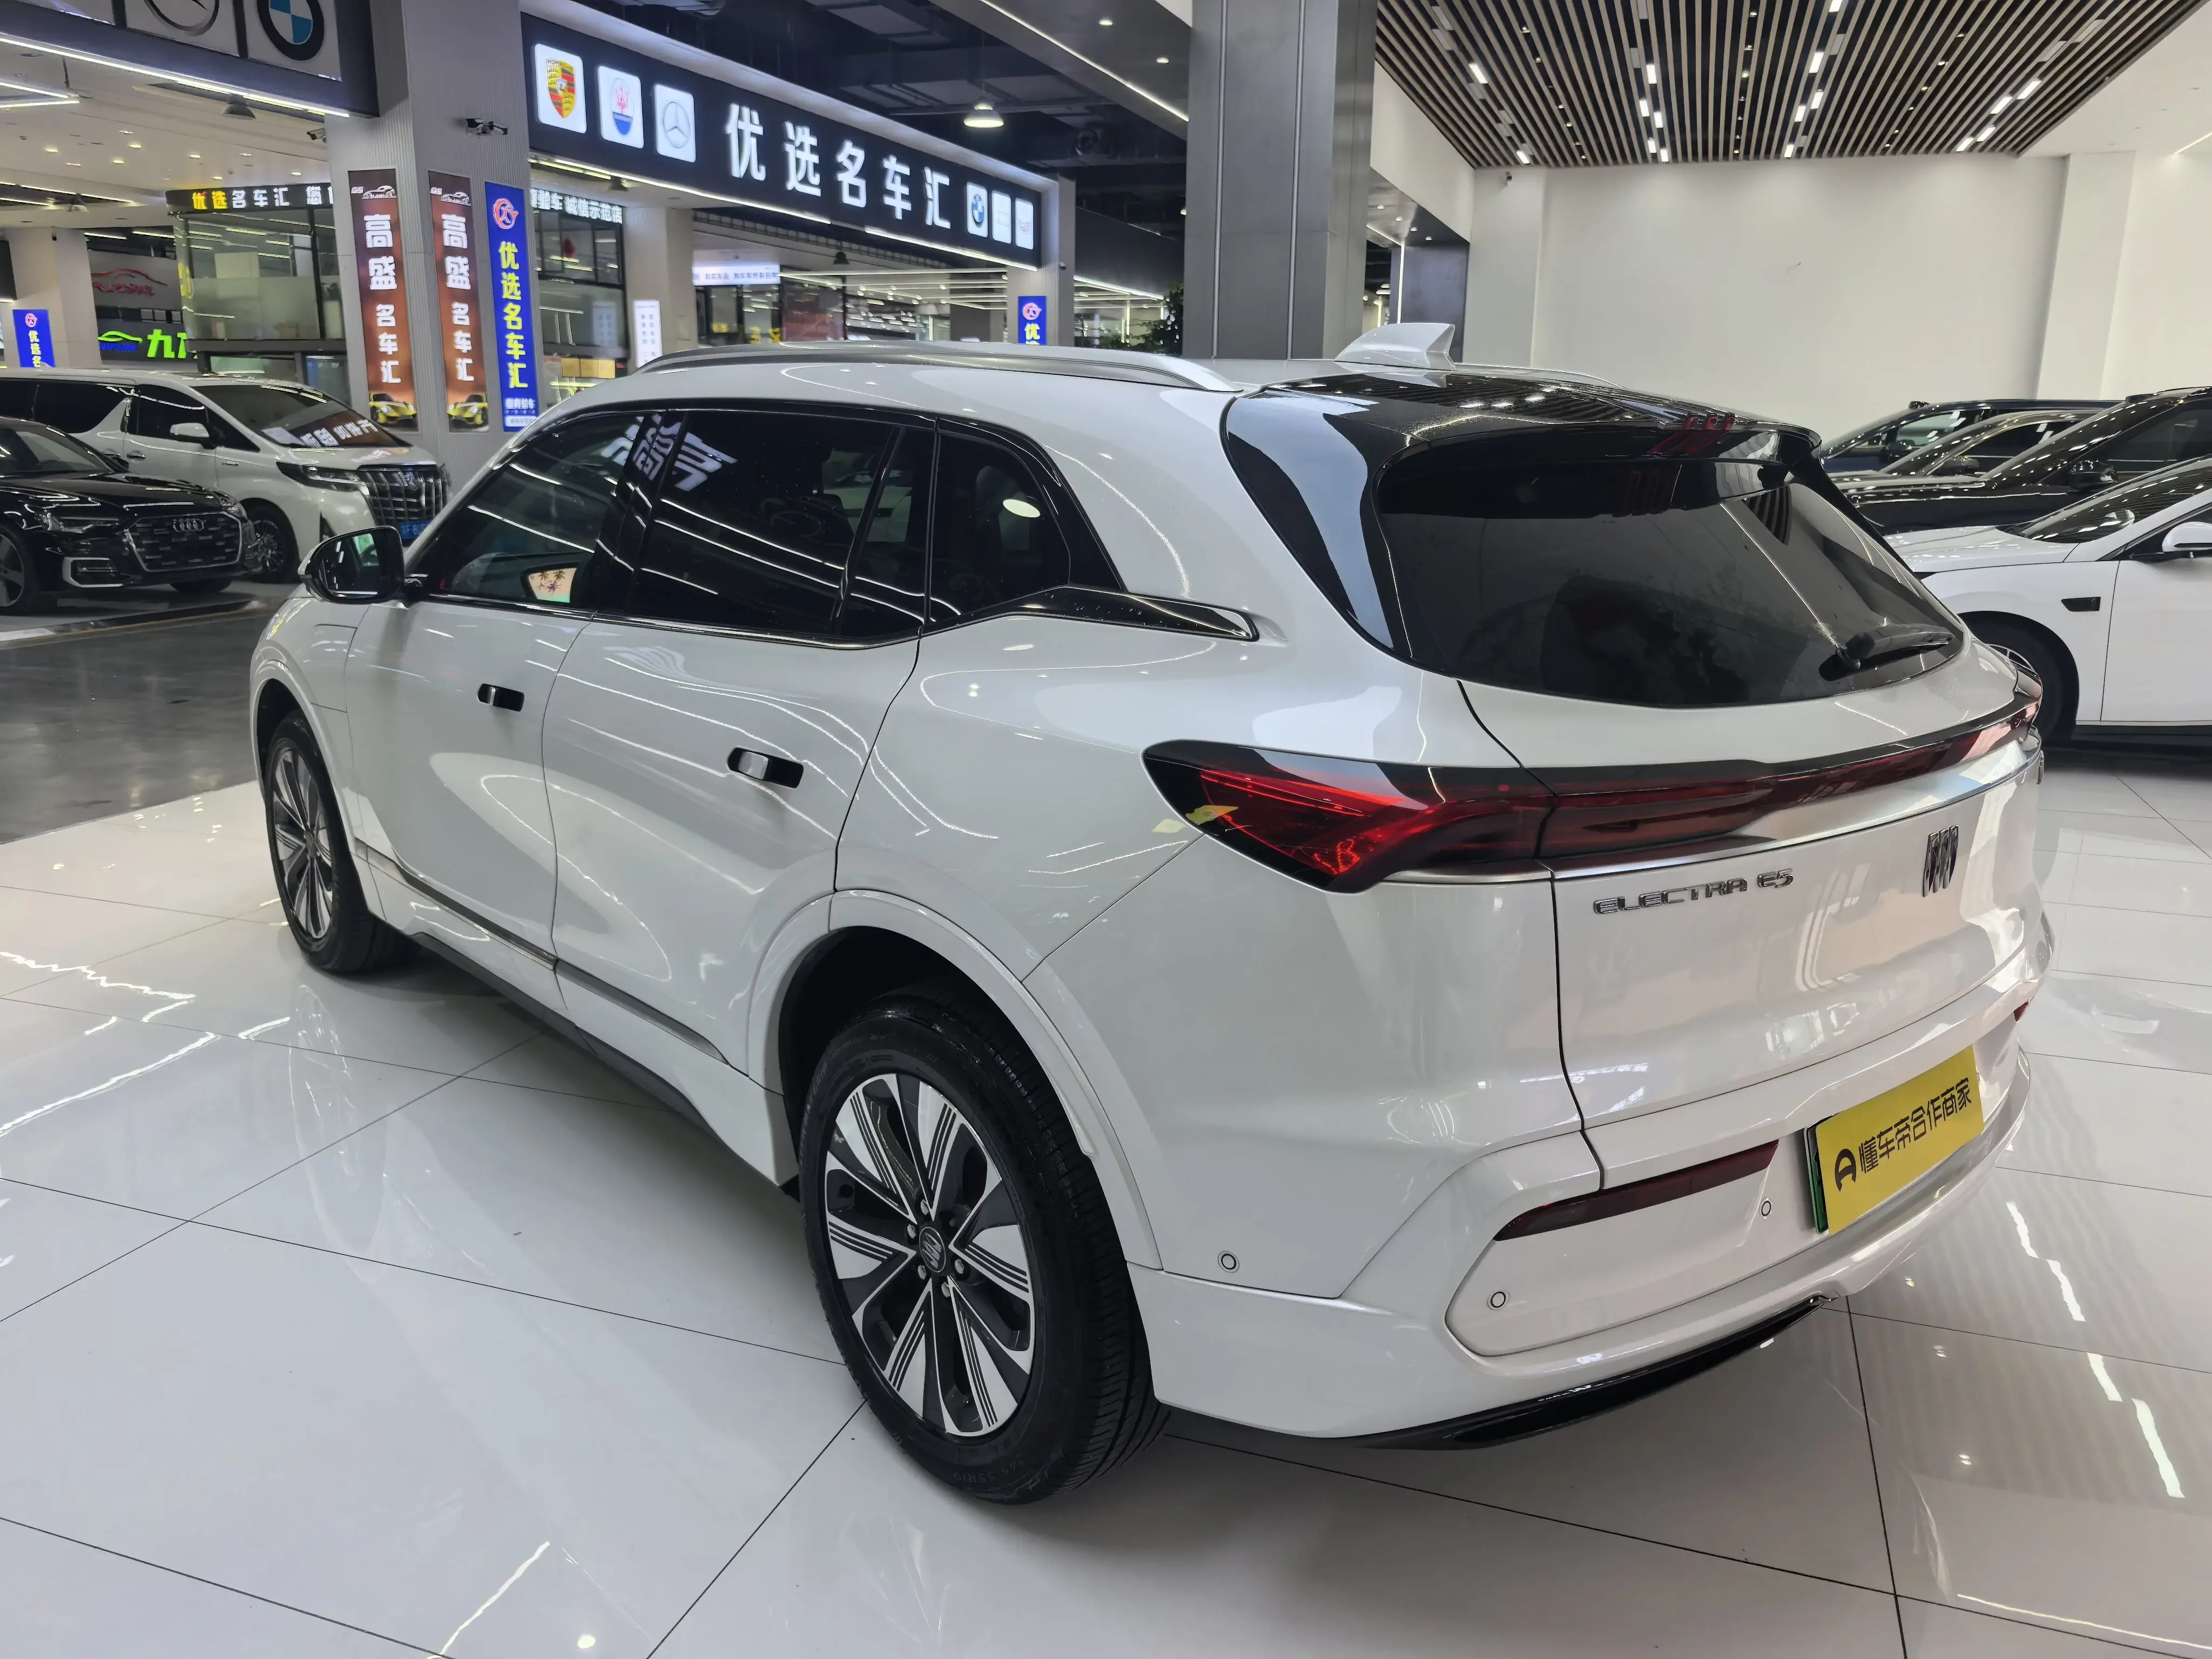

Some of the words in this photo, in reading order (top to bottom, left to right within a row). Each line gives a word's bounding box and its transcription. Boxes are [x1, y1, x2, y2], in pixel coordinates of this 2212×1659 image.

[192, 187, 290, 210] 优选名车汇
[725, 103, 951, 229] 优选名车汇
[363, 214, 401, 384] 高盛名车汇
[441, 214, 475, 382] 高盛名车汇
[498, 241, 528, 389] 优选名车汇
[1594, 878, 1748, 915] ELECTRA
[1757, 868, 1794, 888] E5
[1858, 1077, 1972, 1174] 懂车帝合作商家
